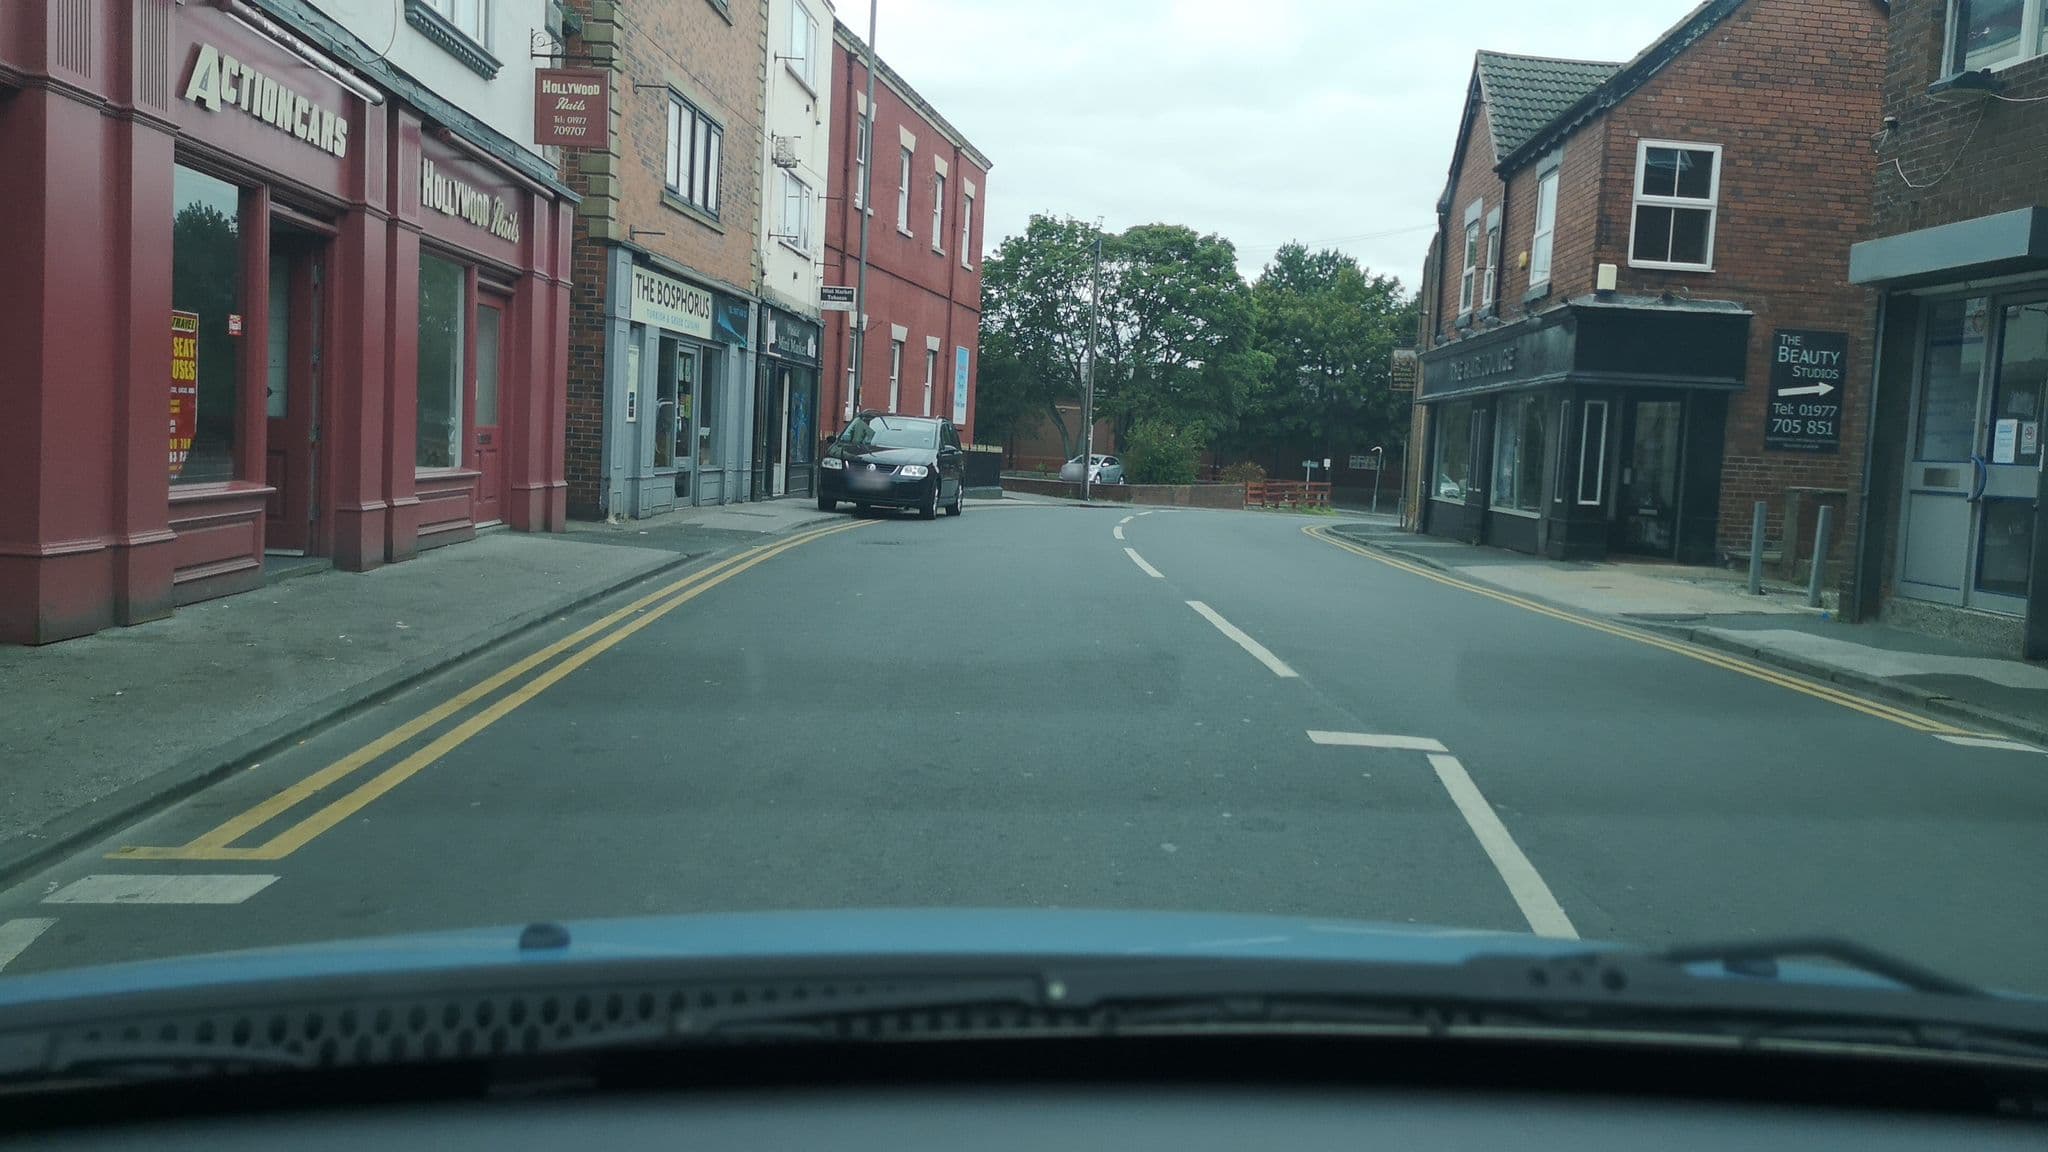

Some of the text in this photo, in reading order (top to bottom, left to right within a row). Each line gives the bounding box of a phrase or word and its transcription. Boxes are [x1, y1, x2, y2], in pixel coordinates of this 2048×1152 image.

[542, 80, 600, 96] HOLLYWOOD
[555, 96, 586, 111] Nails
[567, 116, 587, 125] 01977
[553, 125, 587, 136] 709707
[422, 158, 520, 244] HOLLYWOOD Nails
[635, 273, 711, 320] THE BOSPHORUS
[173, 336, 195, 358] SEAT
[1780, 334, 1801, 346] THE
[1777, 345, 1840, 366] BEAUTY
[1792, 365, 1839, 379] STUDIOS
[1772, 403, 1838, 417] Tel: 01977
[1772, 418, 1833, 435] 705 851
